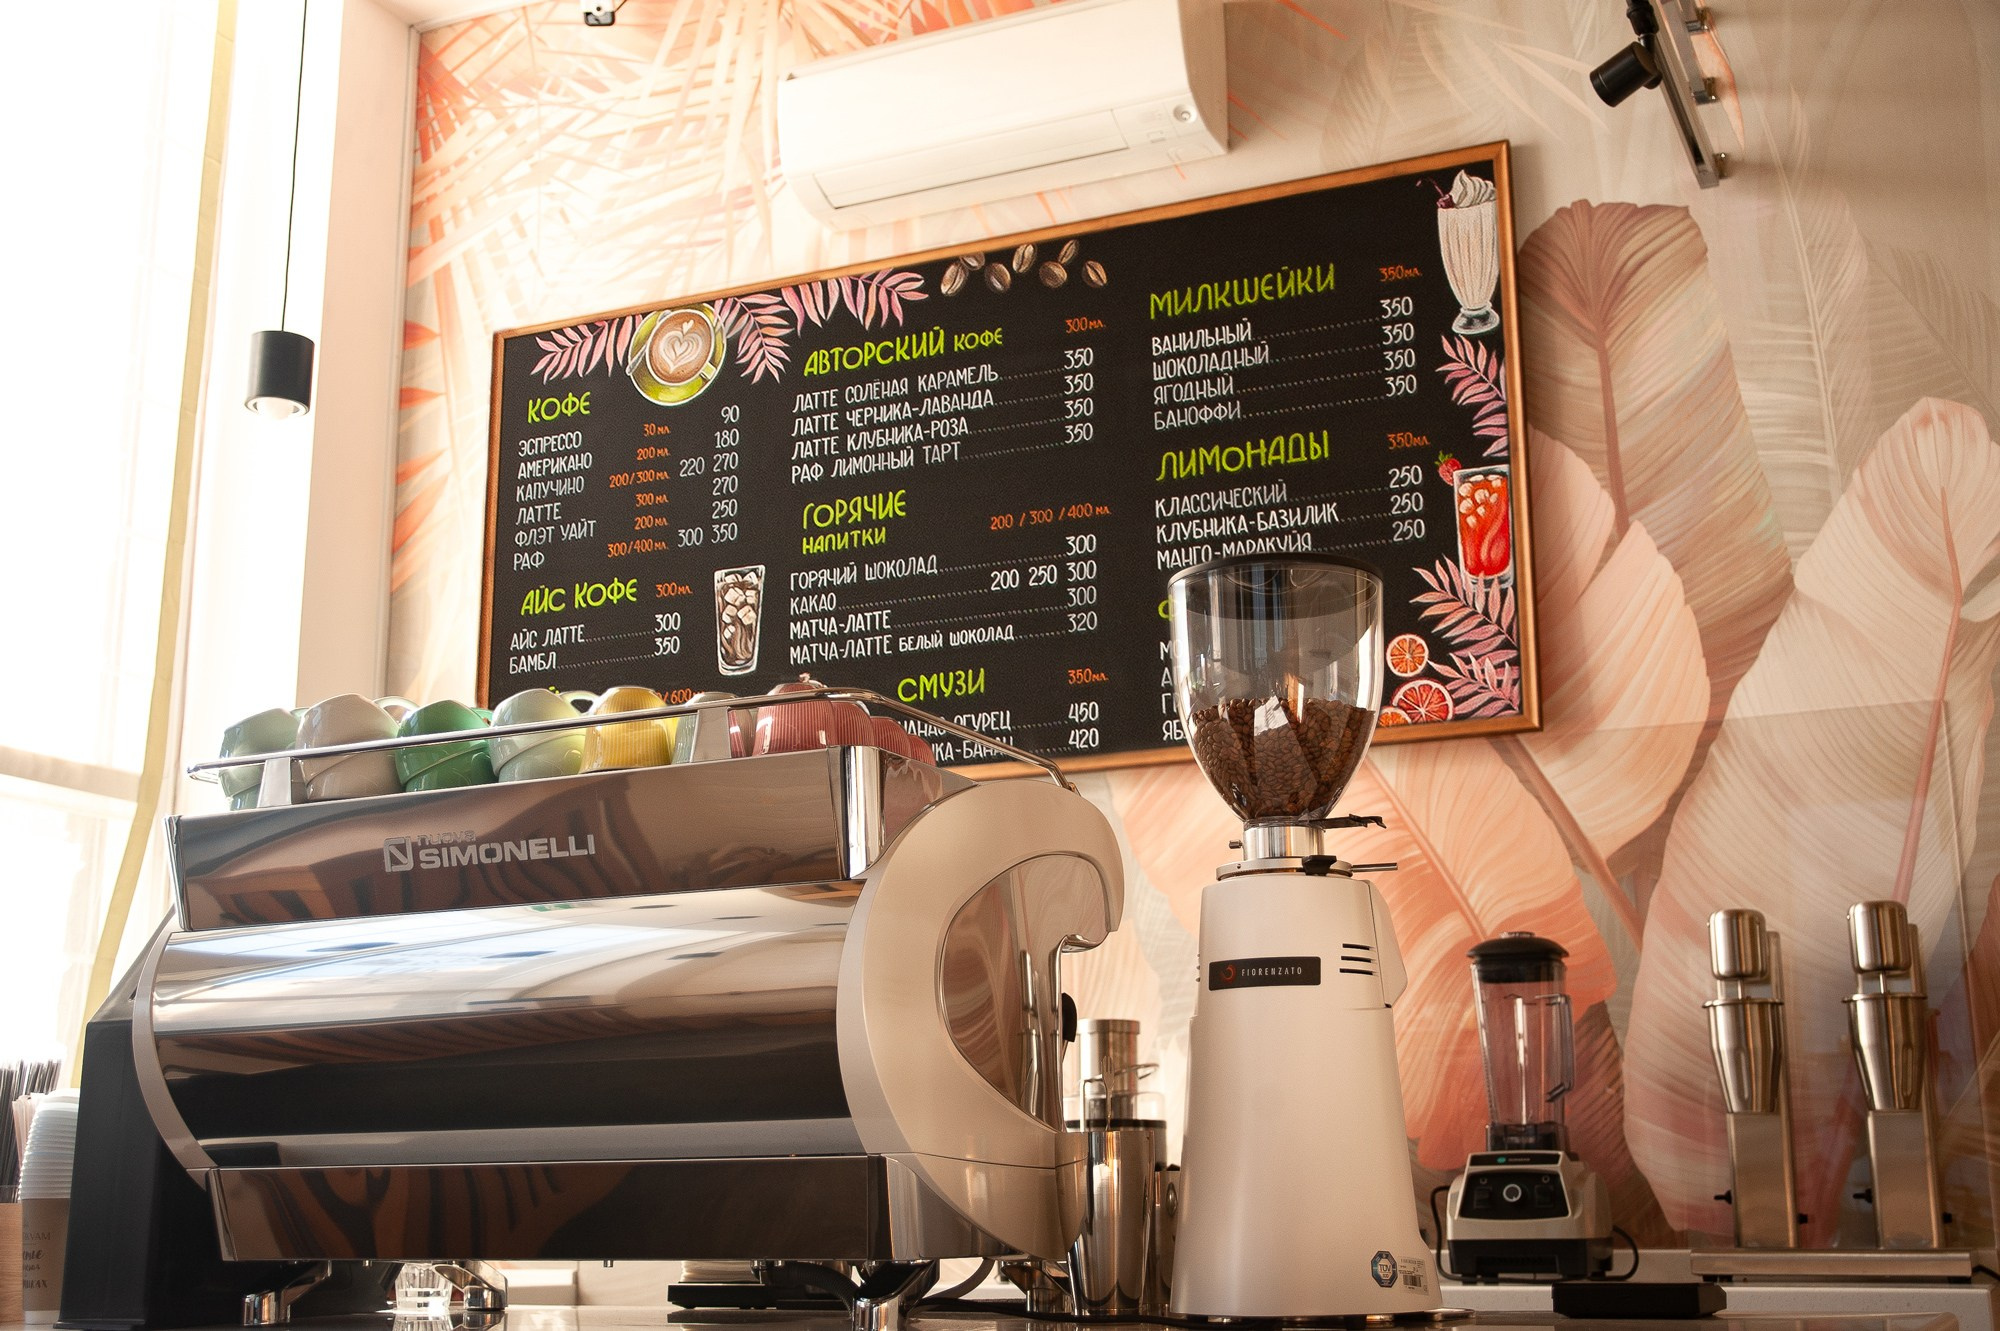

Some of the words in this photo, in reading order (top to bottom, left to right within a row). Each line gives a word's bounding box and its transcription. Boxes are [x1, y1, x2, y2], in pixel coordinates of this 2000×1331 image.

[1150, 263, 1335, 320] МИЛКШЕЙКИ
[804, 326, 944, 376] АВТОРСКИЙ
[954, 328, 1002, 352] КОФЕ
[1152, 318, 1252, 357] ВАНИЛЬНЫЙ
[1380, 296, 1413, 319] 350
[1152, 340, 1269, 381] ШОКОЛАДНЫЙ
[1382, 322, 1414, 345] 350
[792, 388, 839, 413] ЛАТТЕ
[845, 378, 908, 404] СОЛЁНАЯ
[918, 363, 998, 392] КАРАМЕЛЬ
[1064, 347, 1094, 370] 350
[1154, 373, 1234, 406] ЯГОДНЫЙ
[1384, 348, 1416, 370] 350
[1154, 401, 1240, 430] БАНОФФИ
[1385, 374, 1417, 397] 350
[528, 391, 590, 424] КОФЕ
[792, 412, 839, 436] ЛАТТЕ
[846, 389, 994, 428] ЧЕРНИКА-ЛАВАНДА
[1064, 372, 1094, 395] 350
[792, 436, 839, 460] ЛАТТЕ
[847, 416, 969, 452] КЛУБНИКА-РОЗА
[1064, 398, 1094, 420] 350
[518, 452, 592, 480] АМЕРИКАНО
[714, 428, 739, 449] 180
[519, 430, 582, 456] ЭСПРЕССО
[721, 405, 740, 424] 90
[792, 462, 823, 484] РАФ
[831, 446, 914, 478] ЛИМОННЫЙ
[922, 441, 960, 465] ТАРТ
[1064, 422, 1093, 444] 350
[1156, 430, 1329, 481] ЛИМОНАДЫ
[516, 476, 584, 502] КАПУЧИНО
[679, 457, 705, 478] 220
[712, 452, 738, 472] 270
[516, 502, 562, 525] ЛАТТЕ
[712, 475, 738, 496] 270
[1156, 479, 1287, 518] КЛАССИЧЕСКИЙ
[1388, 466, 1422, 489] 250
[515, 526, 554, 548] ФЛЭТ
[560, 518, 597, 542] УАЙТ
[712, 499, 738, 519] 250
[802, 489, 906, 530] ГОРЯЧИЕ
[802, 526, 886, 555] НАПИТКИ
[990, 514, 1014, 531] 200
[1030, 509, 1053, 524] 300
[1068, 502, 1092, 518] 400
[1157, 502, 1339, 544] КЛУБНИКА-БАЗИЛИК
[1390, 492, 1423, 514] 250
[1392, 519, 1425, 542] 250
[514, 550, 544, 571] РАФ
[678, 527, 703, 548] 300
[711, 522, 738, 544] 350
[790, 562, 857, 592] ГОРЯЧИЙ
[865, 554, 938, 581] ШОКОЛАД
[1066, 534, 1096, 556] 300
[521, 584, 566, 615] АЙС
[574, 577, 638, 609] КОФЕ
[790, 592, 836, 616] КАКАО
[990, 570, 1019, 591] 200
[1029, 565, 1057, 587] 250
[1068, 560, 1096, 582] 300
[790, 610, 892, 640] МАТЧА-ЛАТТЕ
[1068, 586, 1097, 608] 300
[510, 629, 537, 651] АЙС
[542, 624, 585, 646] ЛАТТЕ
[654, 612, 681, 632] 300
[510, 651, 557, 675] БАМБЛ
[654, 636, 680, 656] 350
[790, 634, 892, 666] МАТЧА-ЛАТТЕ
[898, 630, 942, 652] БЕЛЫЙ
[950, 624, 1014, 648] ШОКОЛАД
[1068, 612, 1098, 634] 320
[898, 667, 984, 702] СМУЗИ
[1068, 701, 1099, 723] 450
[1068, 727, 1099, 750] 420
[416, 830, 476, 846] nuova
[419, 834, 596, 870] SIMONELLI
[1242, 967, 1302, 976] FIORENZATO
